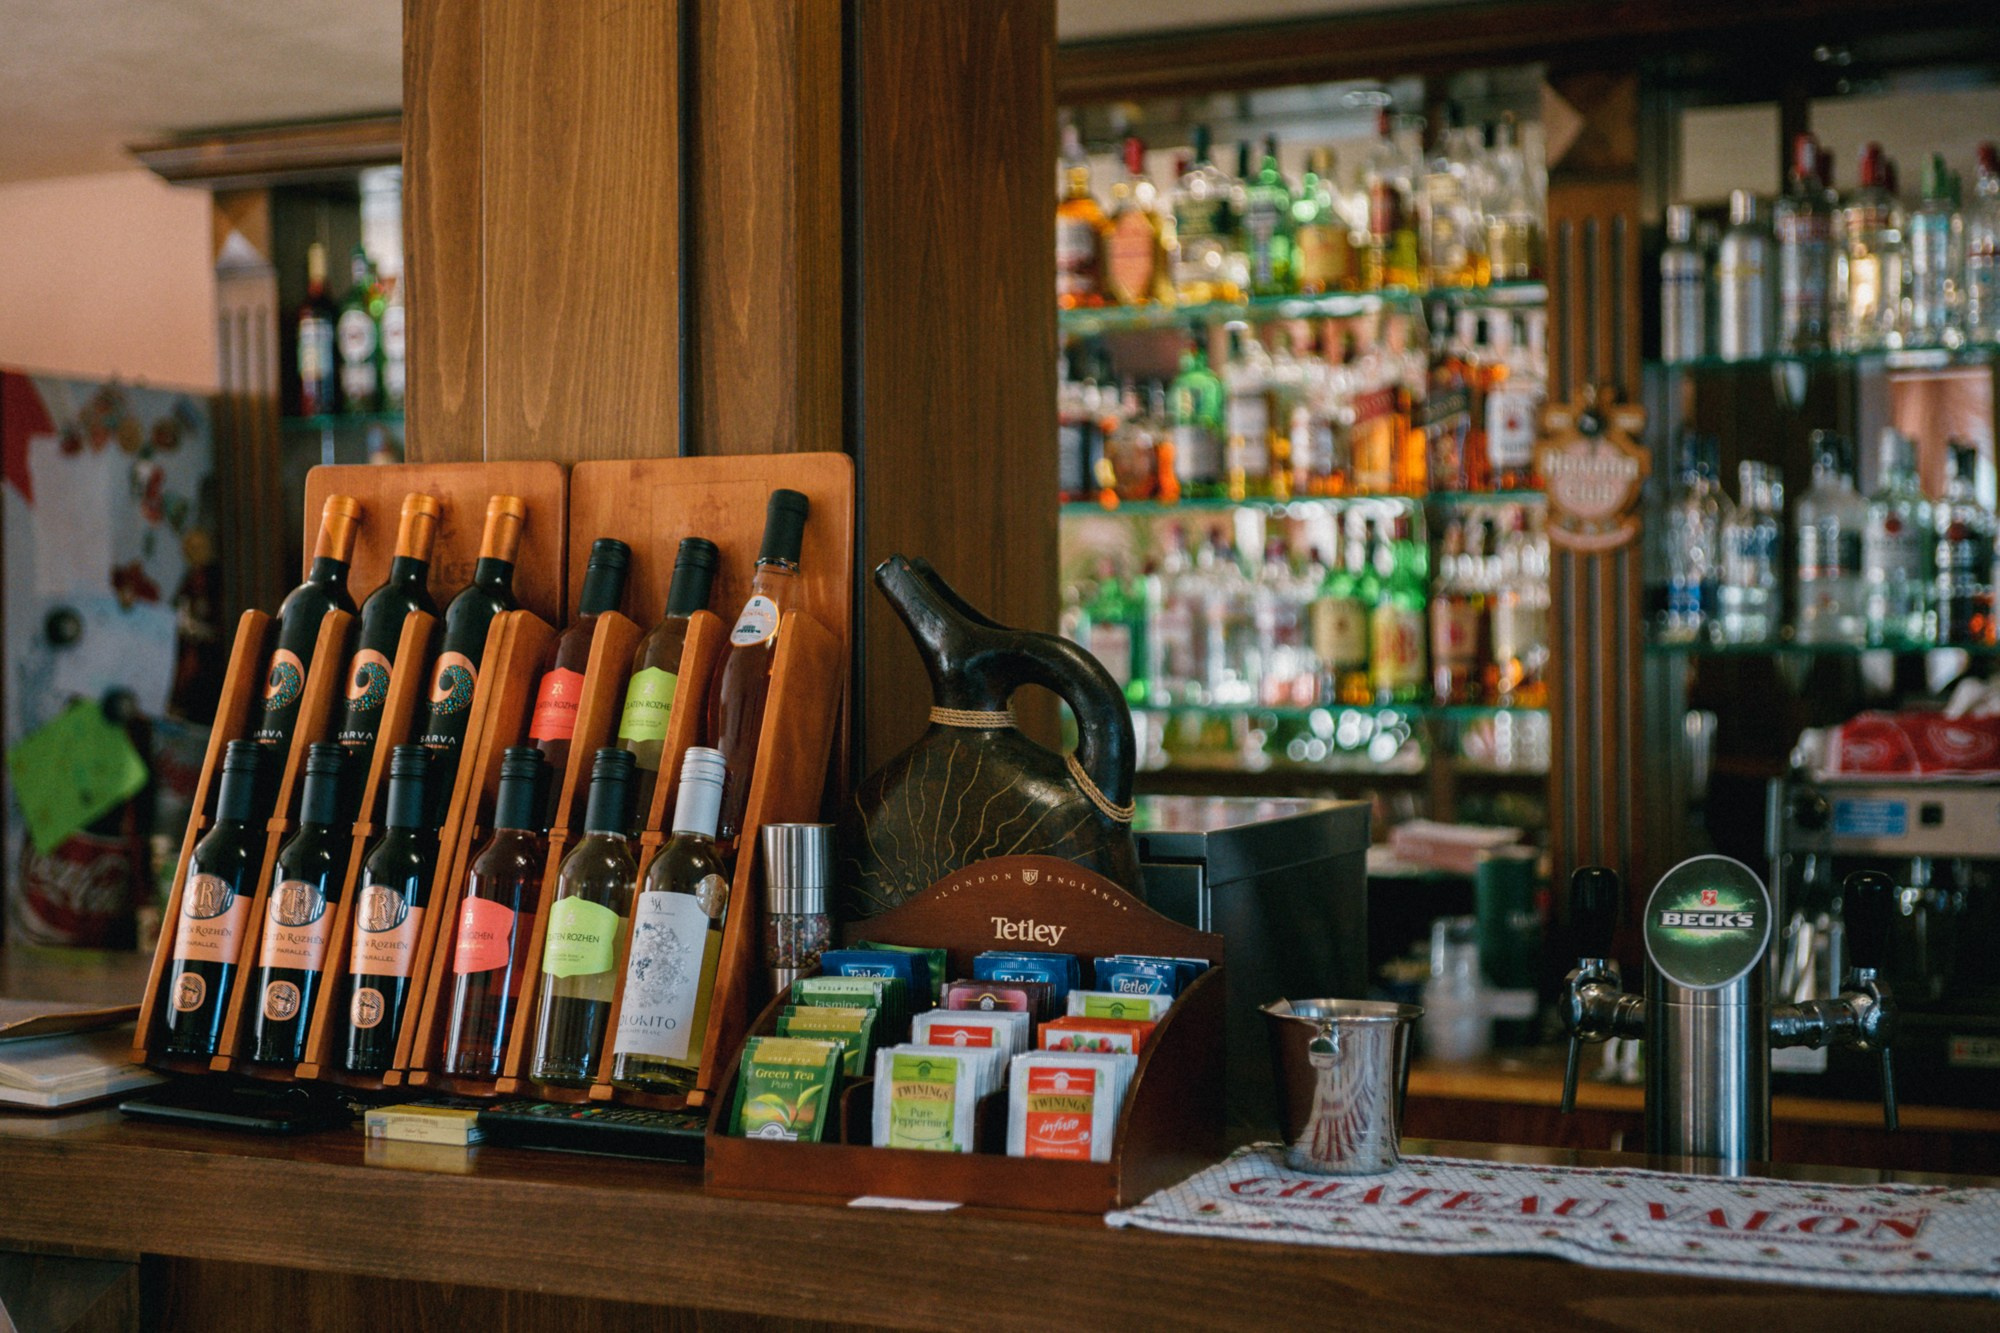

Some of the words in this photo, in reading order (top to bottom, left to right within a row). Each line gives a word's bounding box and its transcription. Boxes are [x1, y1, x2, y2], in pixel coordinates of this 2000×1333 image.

[646, 701, 672, 712] ROZHE
[942, 873, 1012, 898] LONDON
[1046, 875, 1120, 907] ENGLAND
[1661, 911, 1754, 928] BECK'S
[566, 932, 600, 944] ROZHEN
[991, 916, 1067, 947] Tetley
[1118, 978, 1154, 995] Tetley
[755, 1068, 790, 1080] Green
[794, 1069, 815, 1081] Tea
[771, 1080, 794, 1090] Pure
[896, 1083, 950, 1100] TWININGS
[910, 1107, 934, 1118] Pure
[1033, 1095, 1088, 1113] TWININGS
[1229, 1177, 1611, 1217] CHATEAU
[1646, 1200, 1932, 1239] VALON
